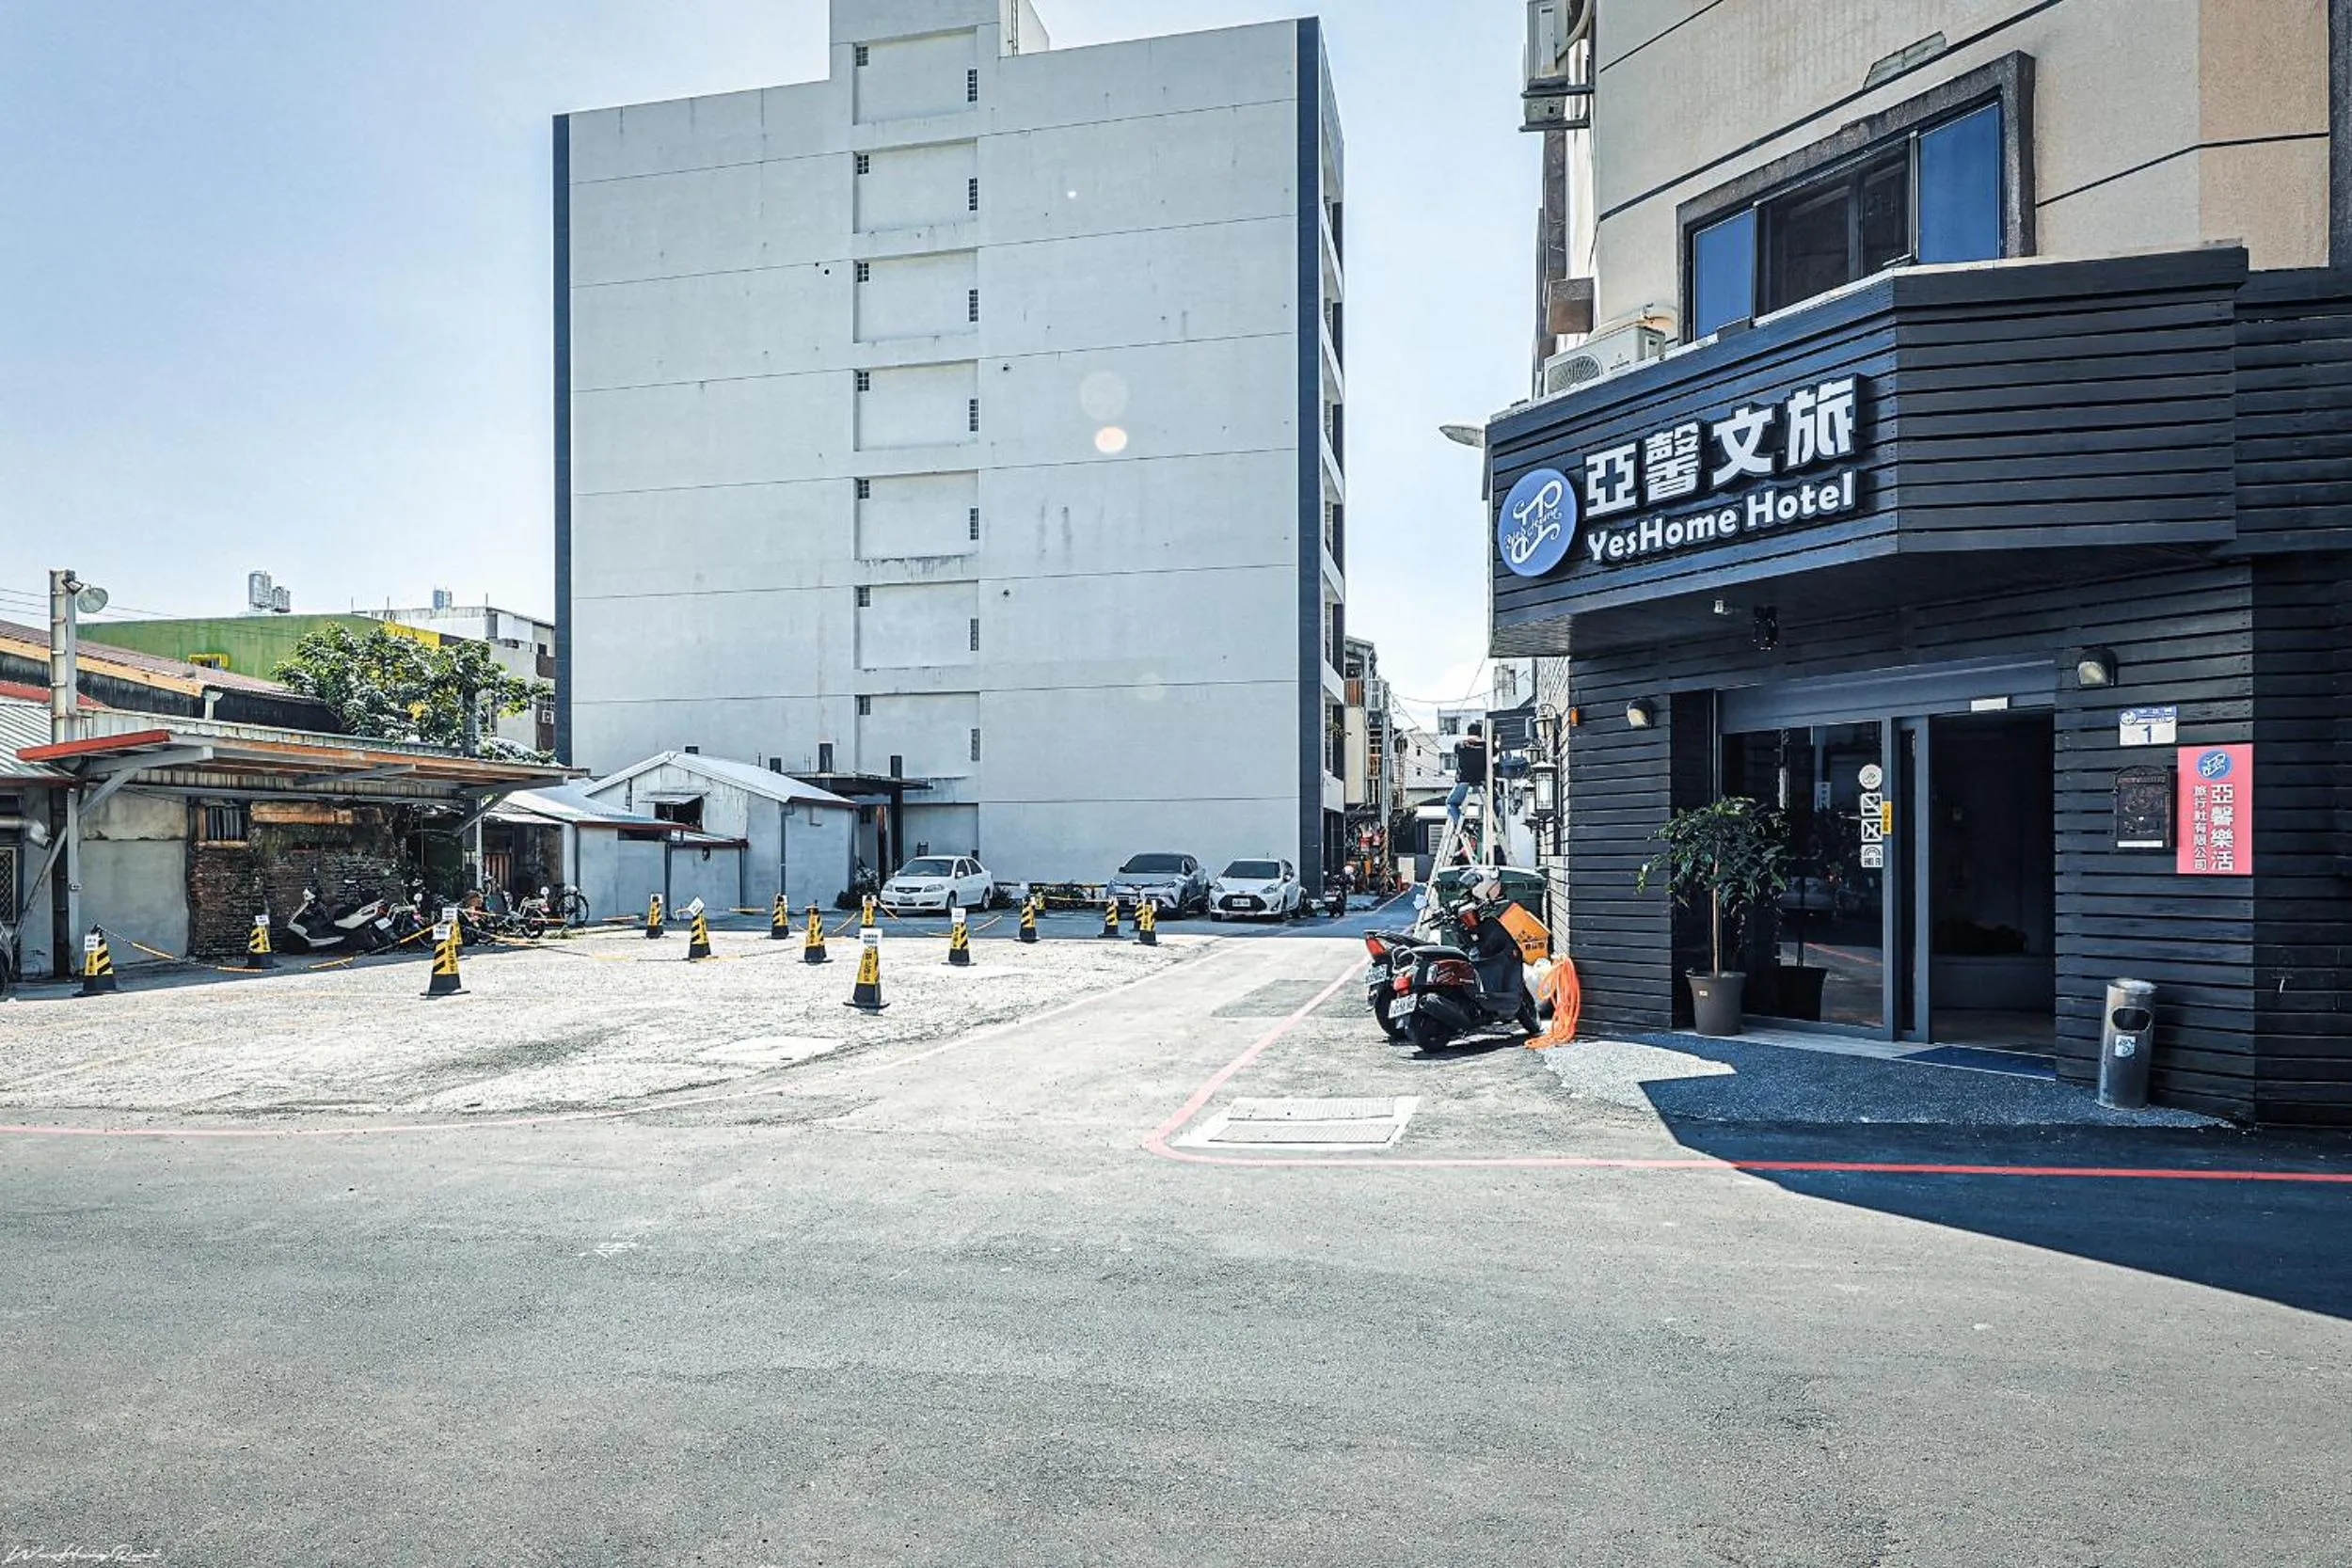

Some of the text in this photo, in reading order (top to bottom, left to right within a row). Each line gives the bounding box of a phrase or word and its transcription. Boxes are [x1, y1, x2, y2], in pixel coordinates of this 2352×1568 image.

[1586, 377, 1854, 517] 亞馨文旅
[1587, 507, 1738, 562] YesHome
[1747, 471, 1854, 527] Hotel
[2142, 725, 2152, 743] 1
[2211, 784, 2233, 871] 亞馨樂活
